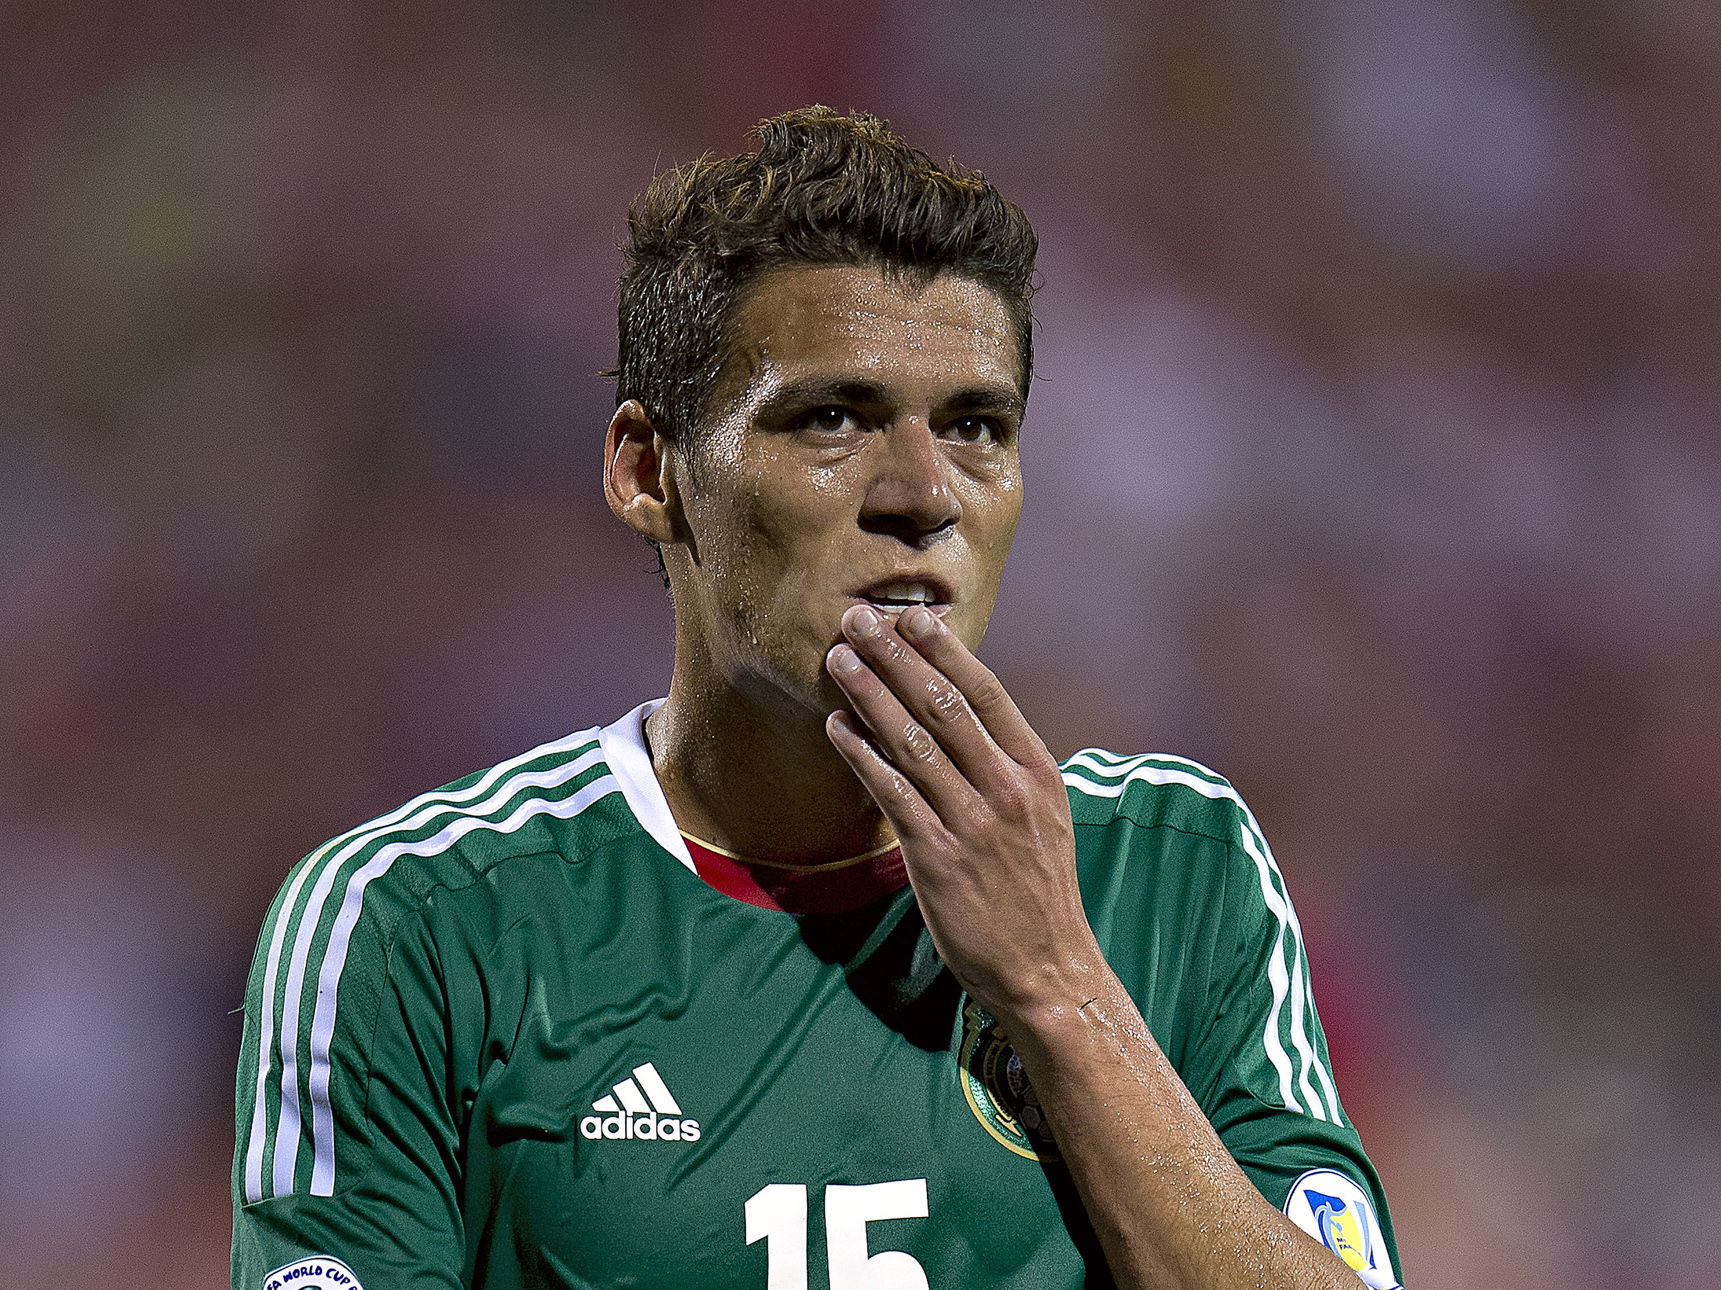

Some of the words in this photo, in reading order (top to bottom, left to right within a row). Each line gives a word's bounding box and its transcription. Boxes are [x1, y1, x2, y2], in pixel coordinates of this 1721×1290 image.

[580, 1110, 701, 1143] adidas
[283, 1265, 323, 1283] WORLD
[325, 1268, 351, 1285] CUP
